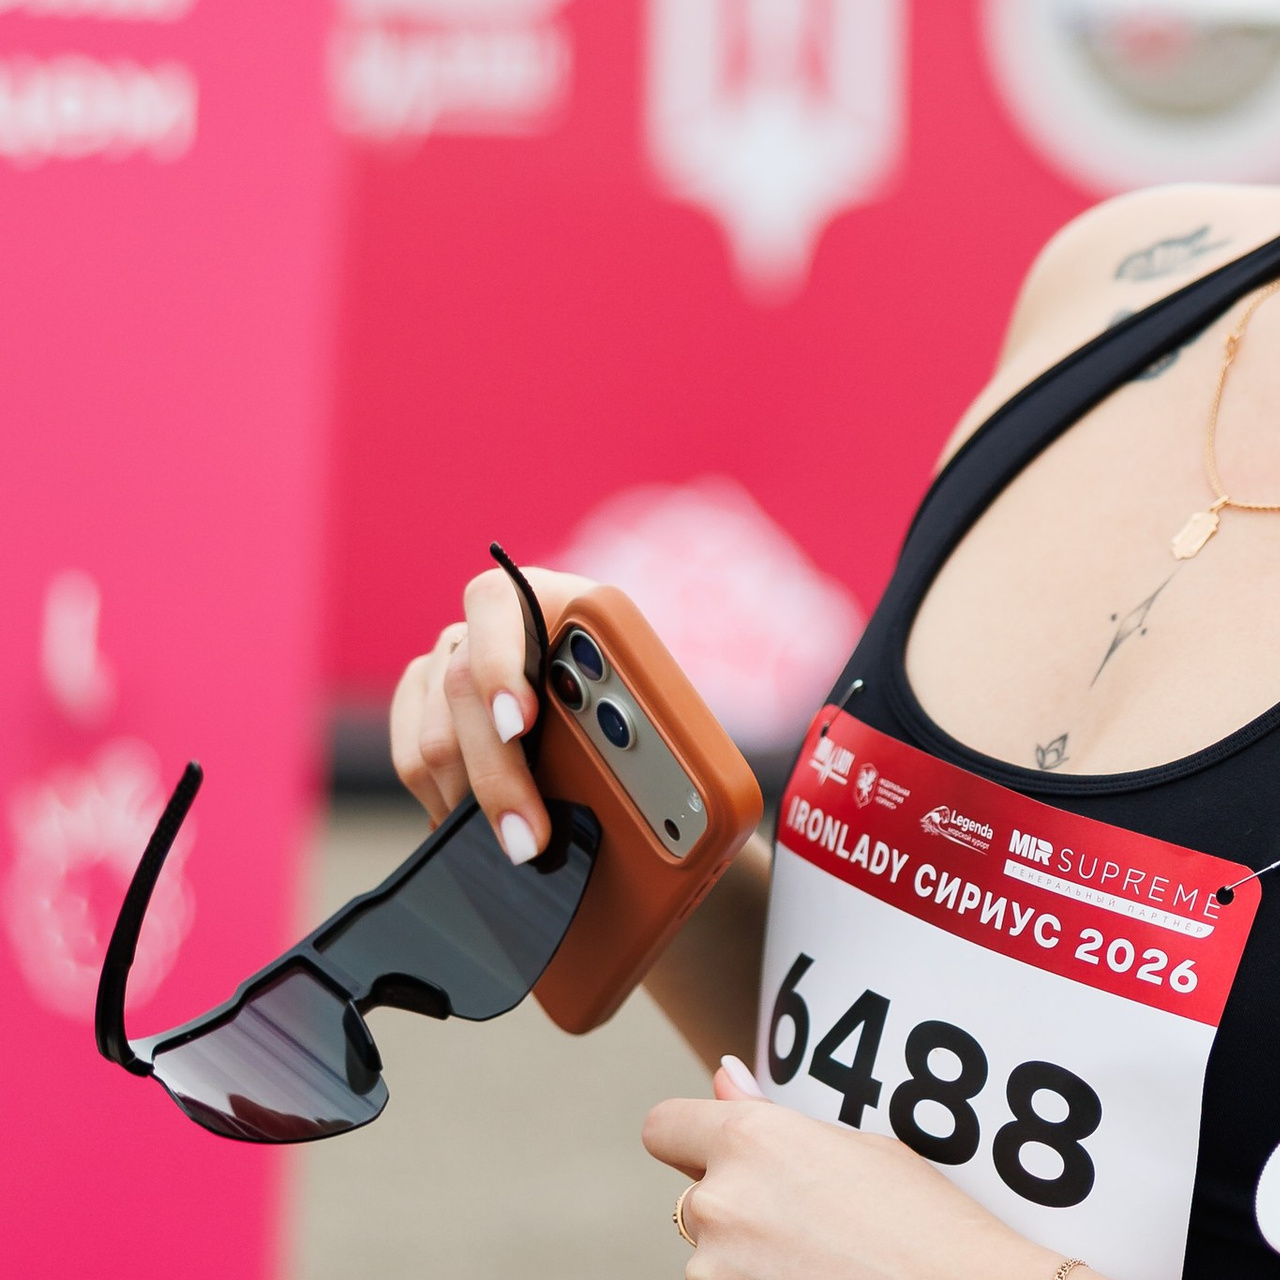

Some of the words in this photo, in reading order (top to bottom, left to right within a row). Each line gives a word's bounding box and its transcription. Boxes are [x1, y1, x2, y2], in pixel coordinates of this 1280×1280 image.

[950, 809, 994, 840] Legenda
[787, 795, 909, 884] IRONLADY
[914, 863, 1062, 949] СИРИУС
[1074, 928, 1199, 994] 2026
[1009, 829, 1054, 866] MIR
[1058, 848, 1221, 919] SUPREME
[1011, 865, 1116, 907] ГЕНЕРАЛЬНЫЙ
[1127, 904, 1203, 934] ПАРТНЕР
[767, 952, 1103, 1209] 6488
